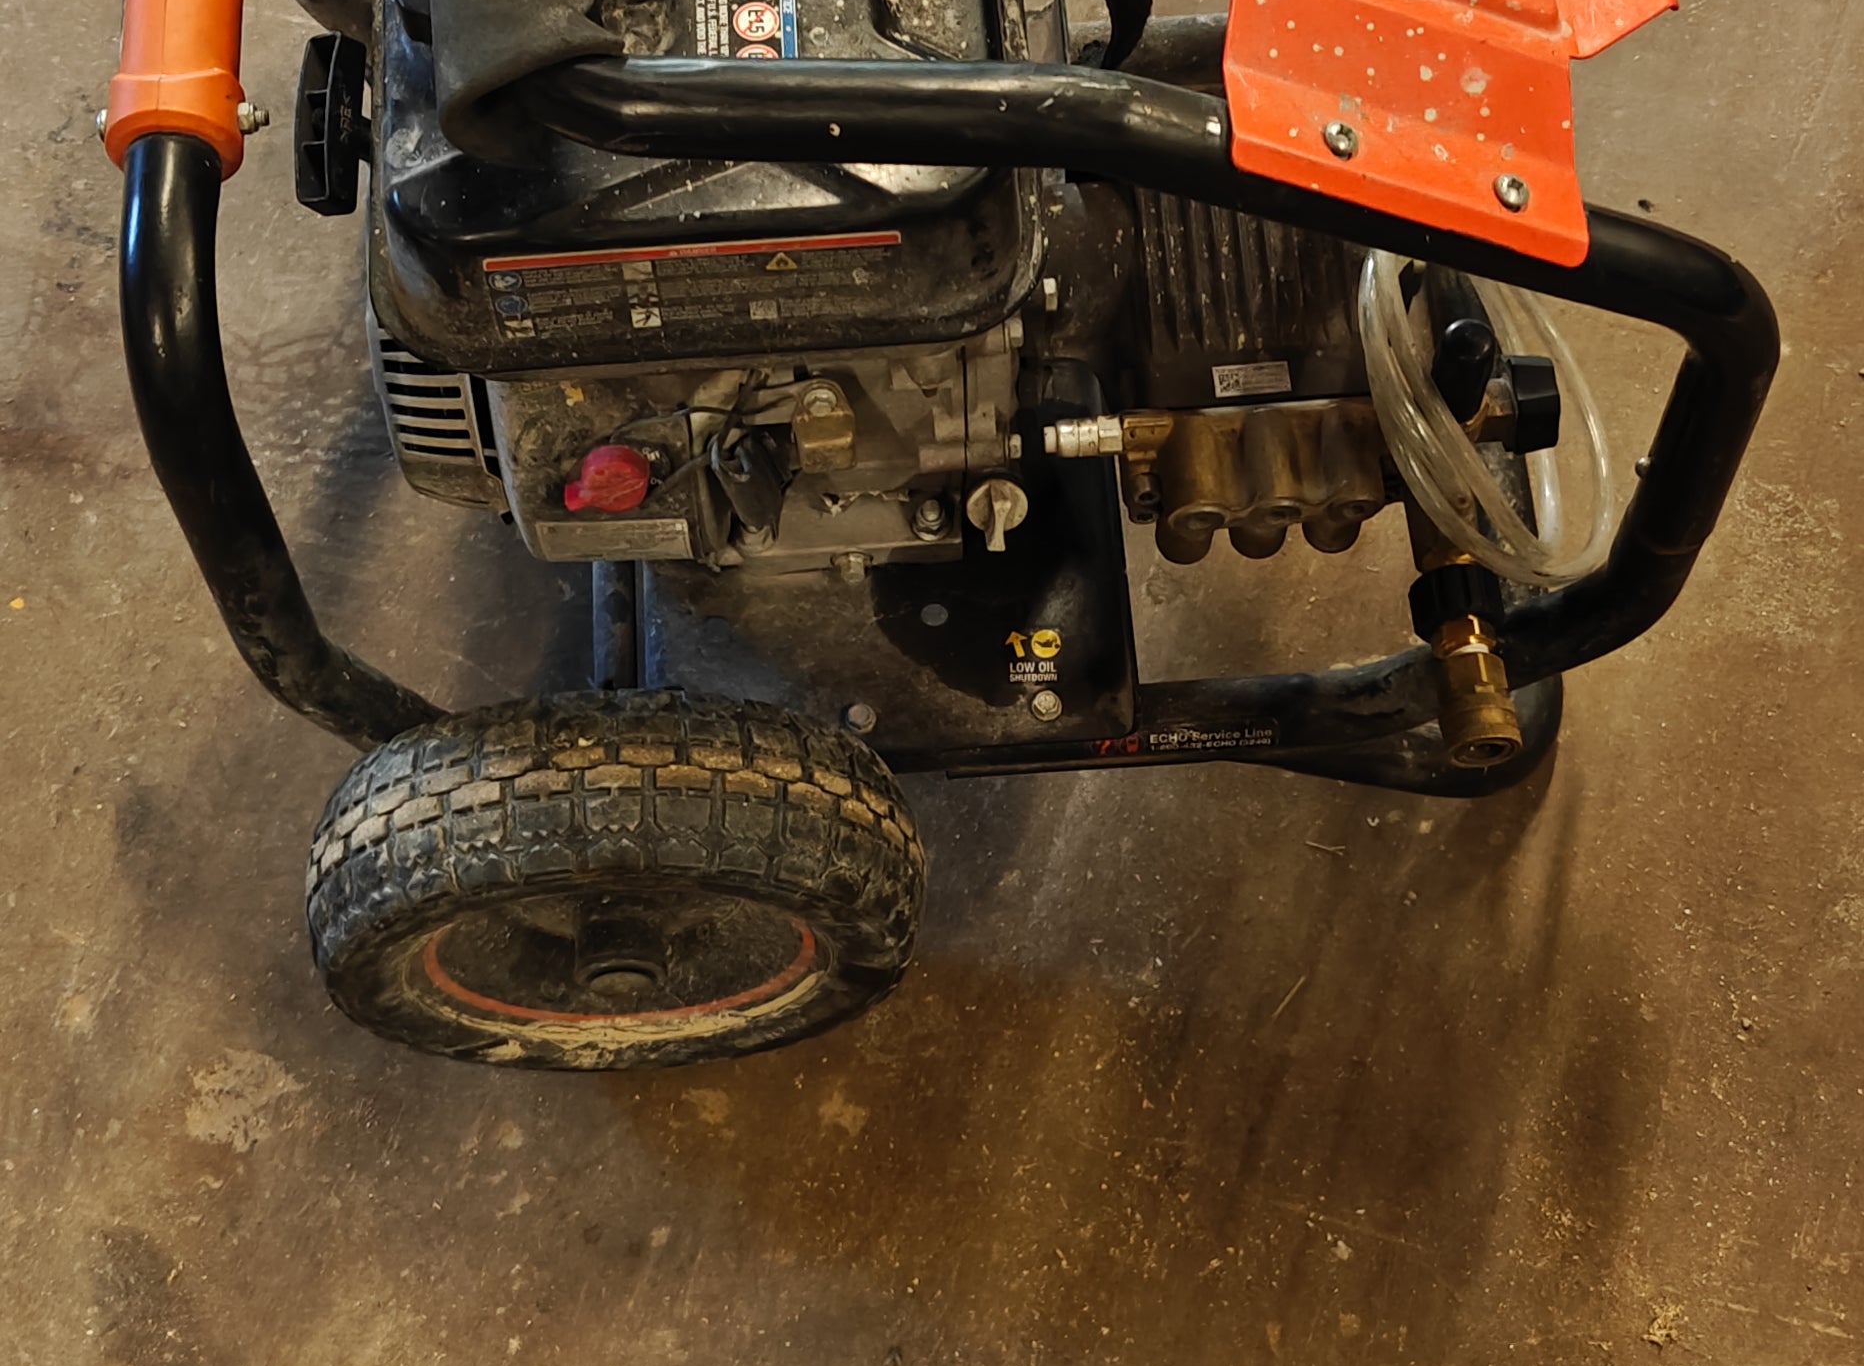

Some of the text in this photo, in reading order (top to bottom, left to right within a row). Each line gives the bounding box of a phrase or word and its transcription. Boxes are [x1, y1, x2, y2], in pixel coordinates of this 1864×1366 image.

[748, 10, 764, 33] E15
[1009, 661, 1056, 673] LOW OIL
[1009, 674, 1057, 682] SHUTDOWN
[1150, 728, 1272, 744] ECHO Service Line
